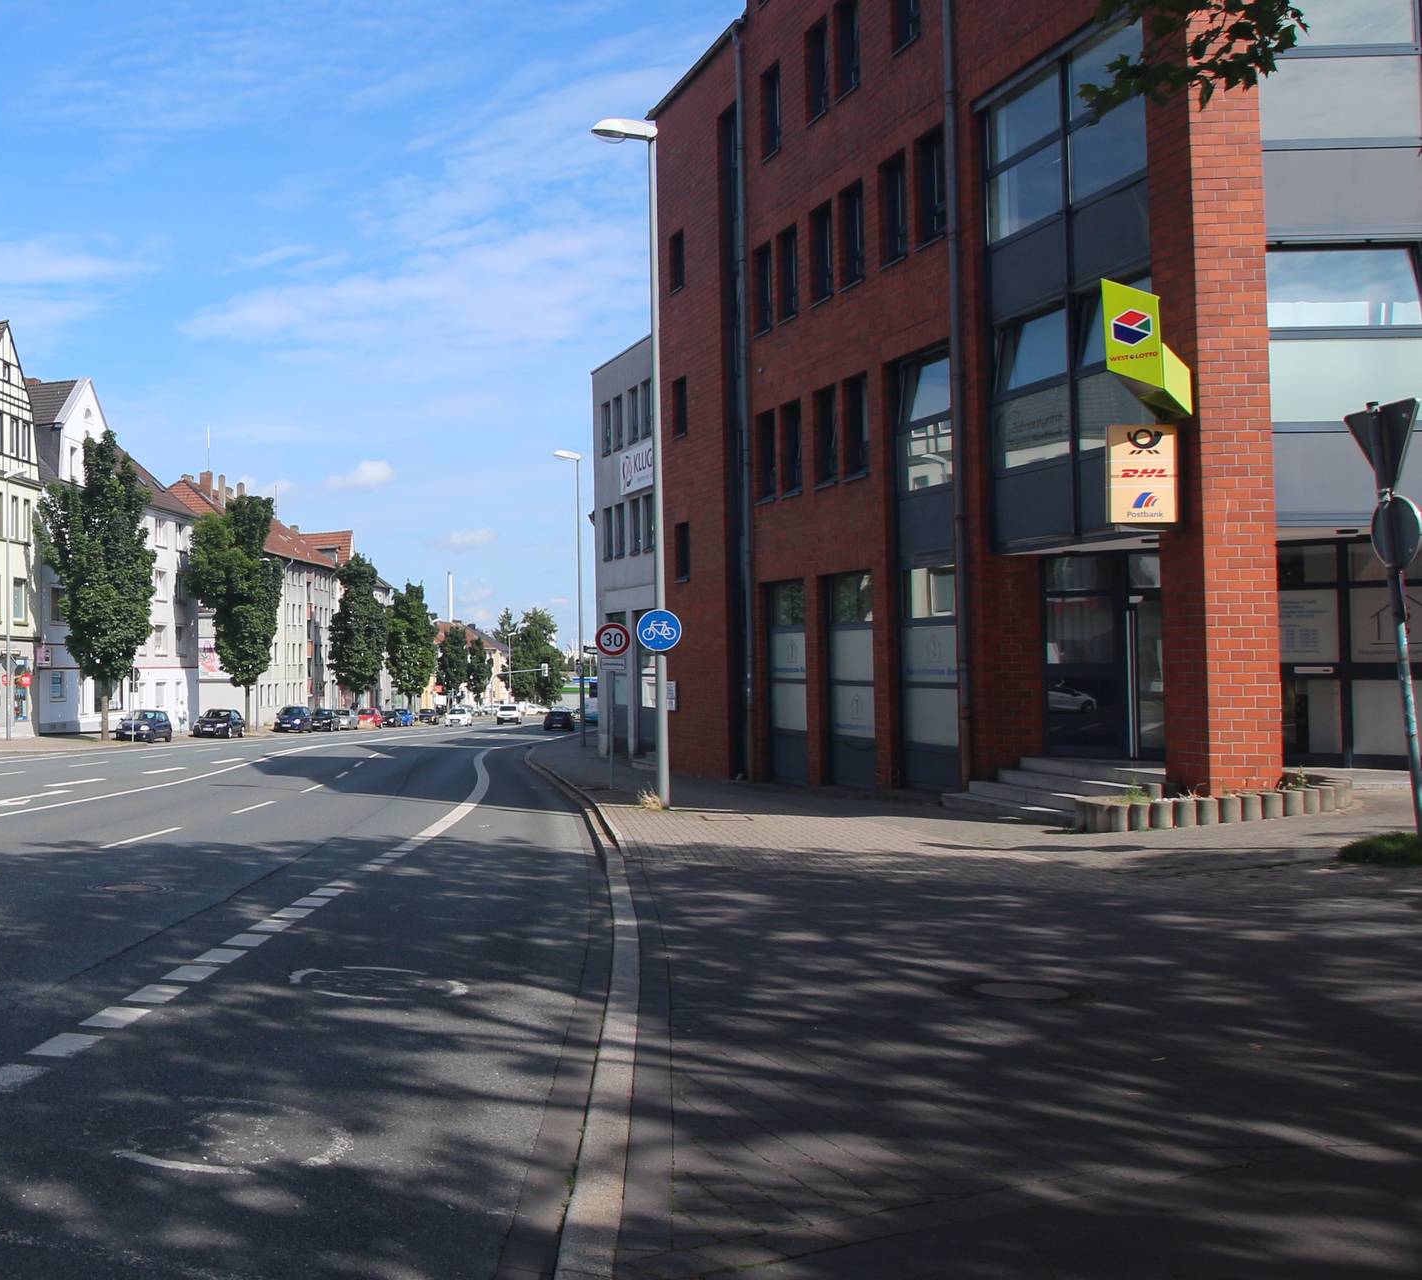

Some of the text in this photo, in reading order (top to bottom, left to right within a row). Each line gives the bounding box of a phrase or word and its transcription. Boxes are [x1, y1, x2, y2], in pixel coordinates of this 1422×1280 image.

[1121, 468, 1169, 478] DHL
[1126, 511, 1163, 519] Postbank
[603, 632, 623, 648] 30
